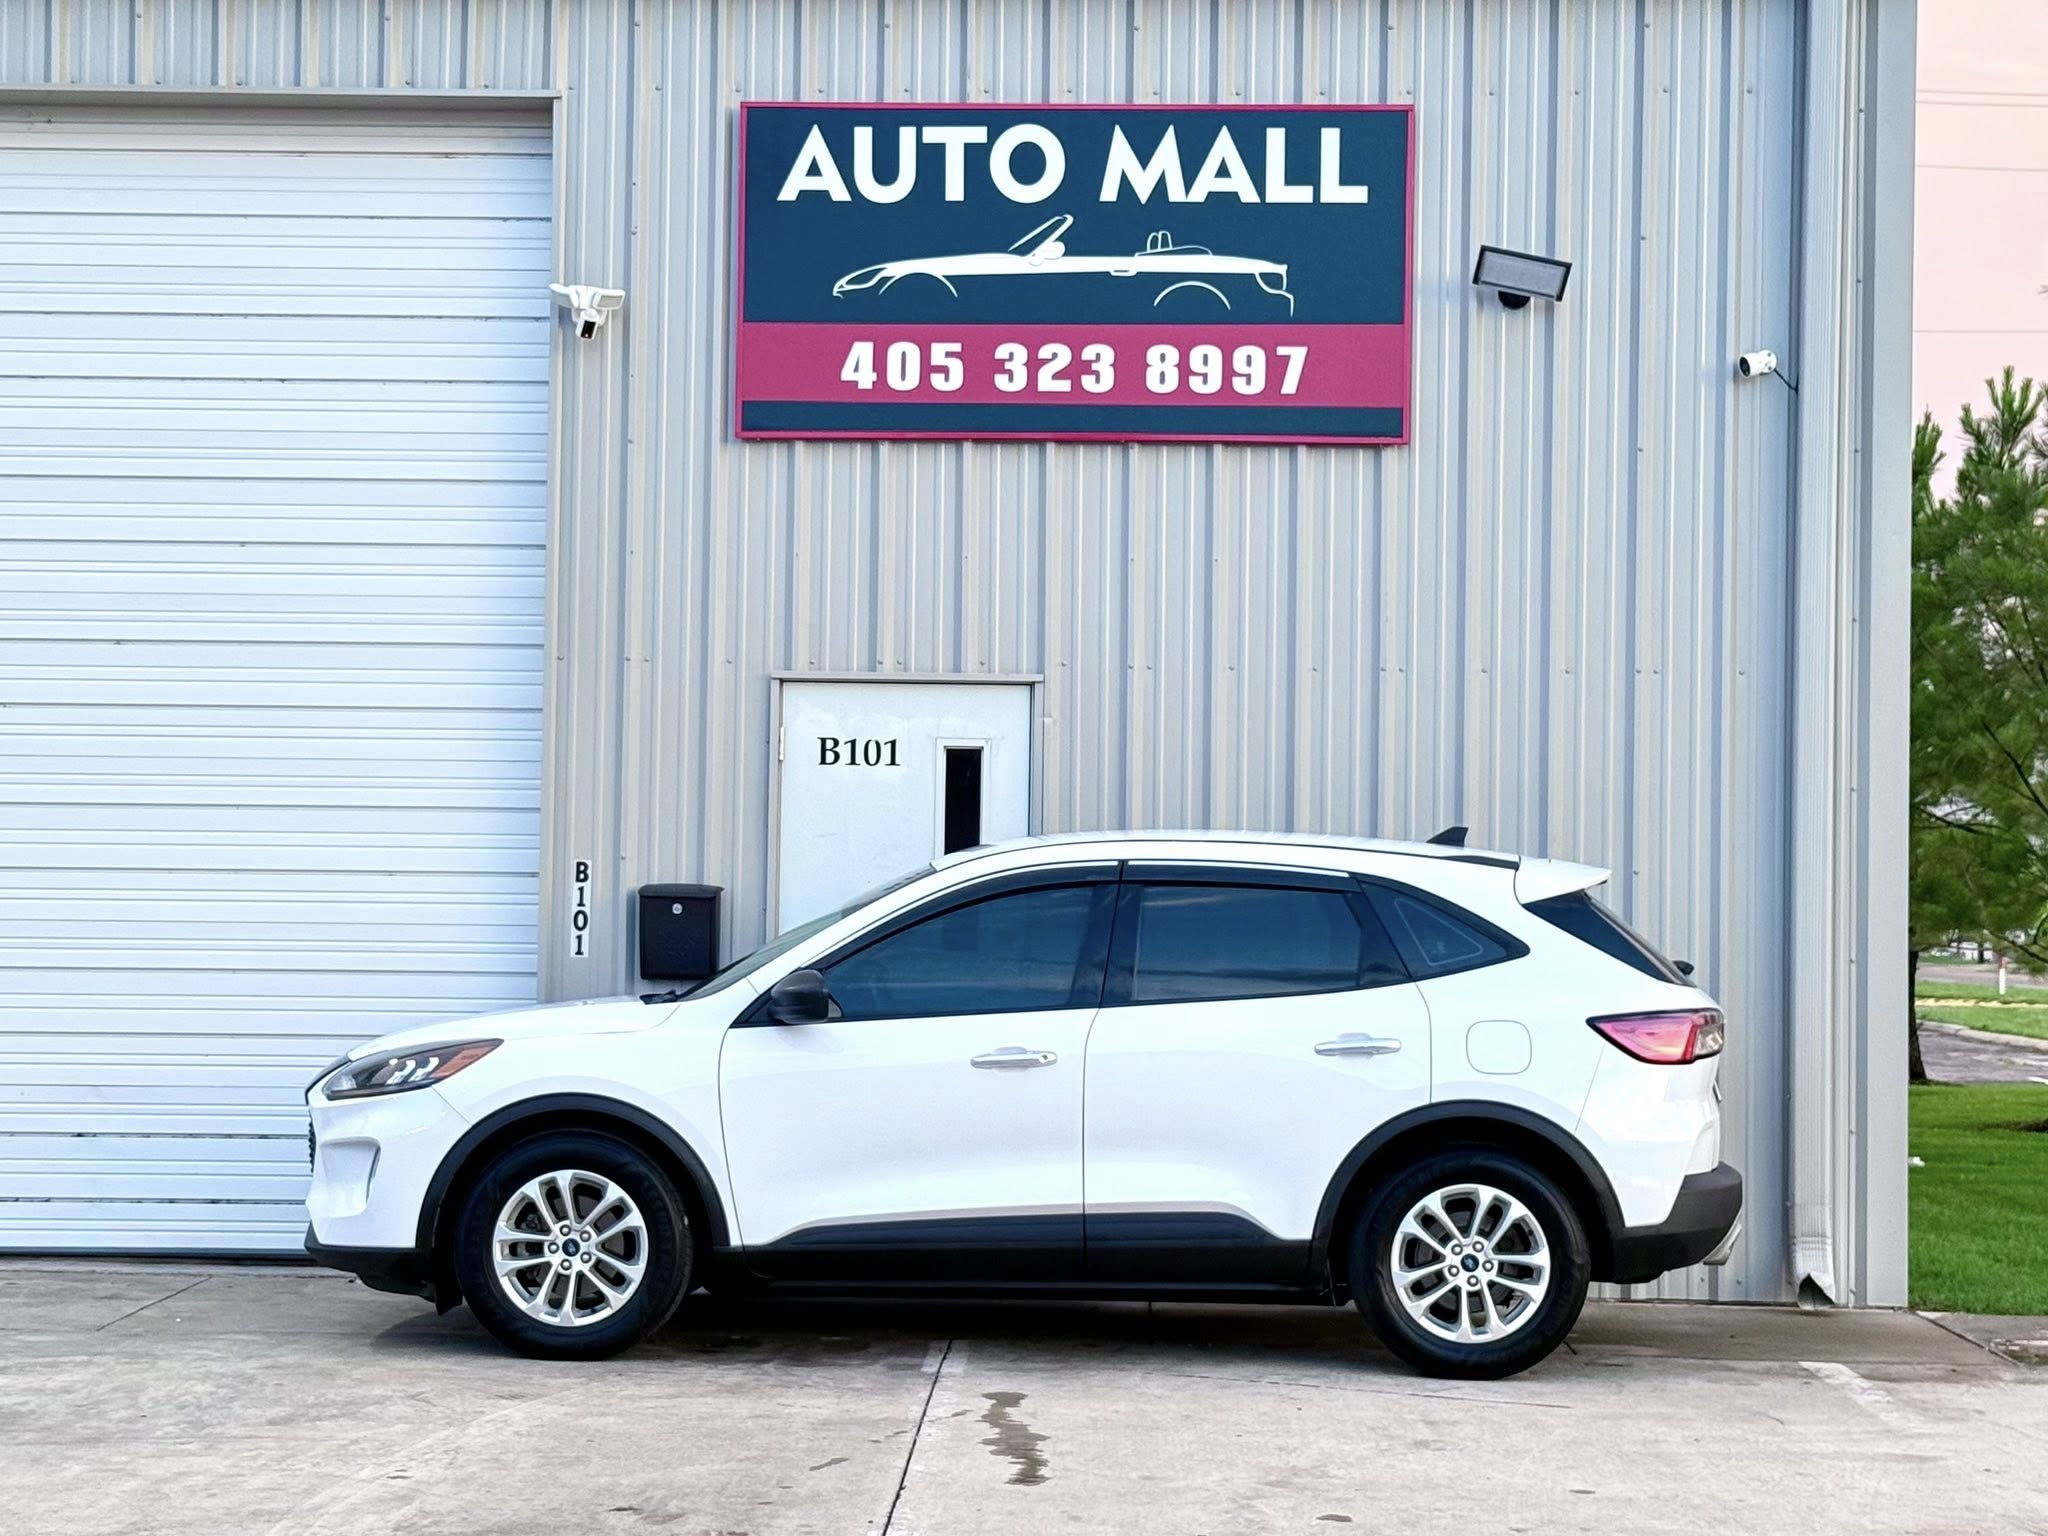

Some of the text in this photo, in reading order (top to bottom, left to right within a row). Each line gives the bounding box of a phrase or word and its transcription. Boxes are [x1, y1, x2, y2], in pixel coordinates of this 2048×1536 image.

[777, 123, 1369, 204] AUTO MALL
[840, 341, 1309, 395] 405 323 8997
[817, 737, 901, 767] B101
[573, 860, 590, 956] B101
